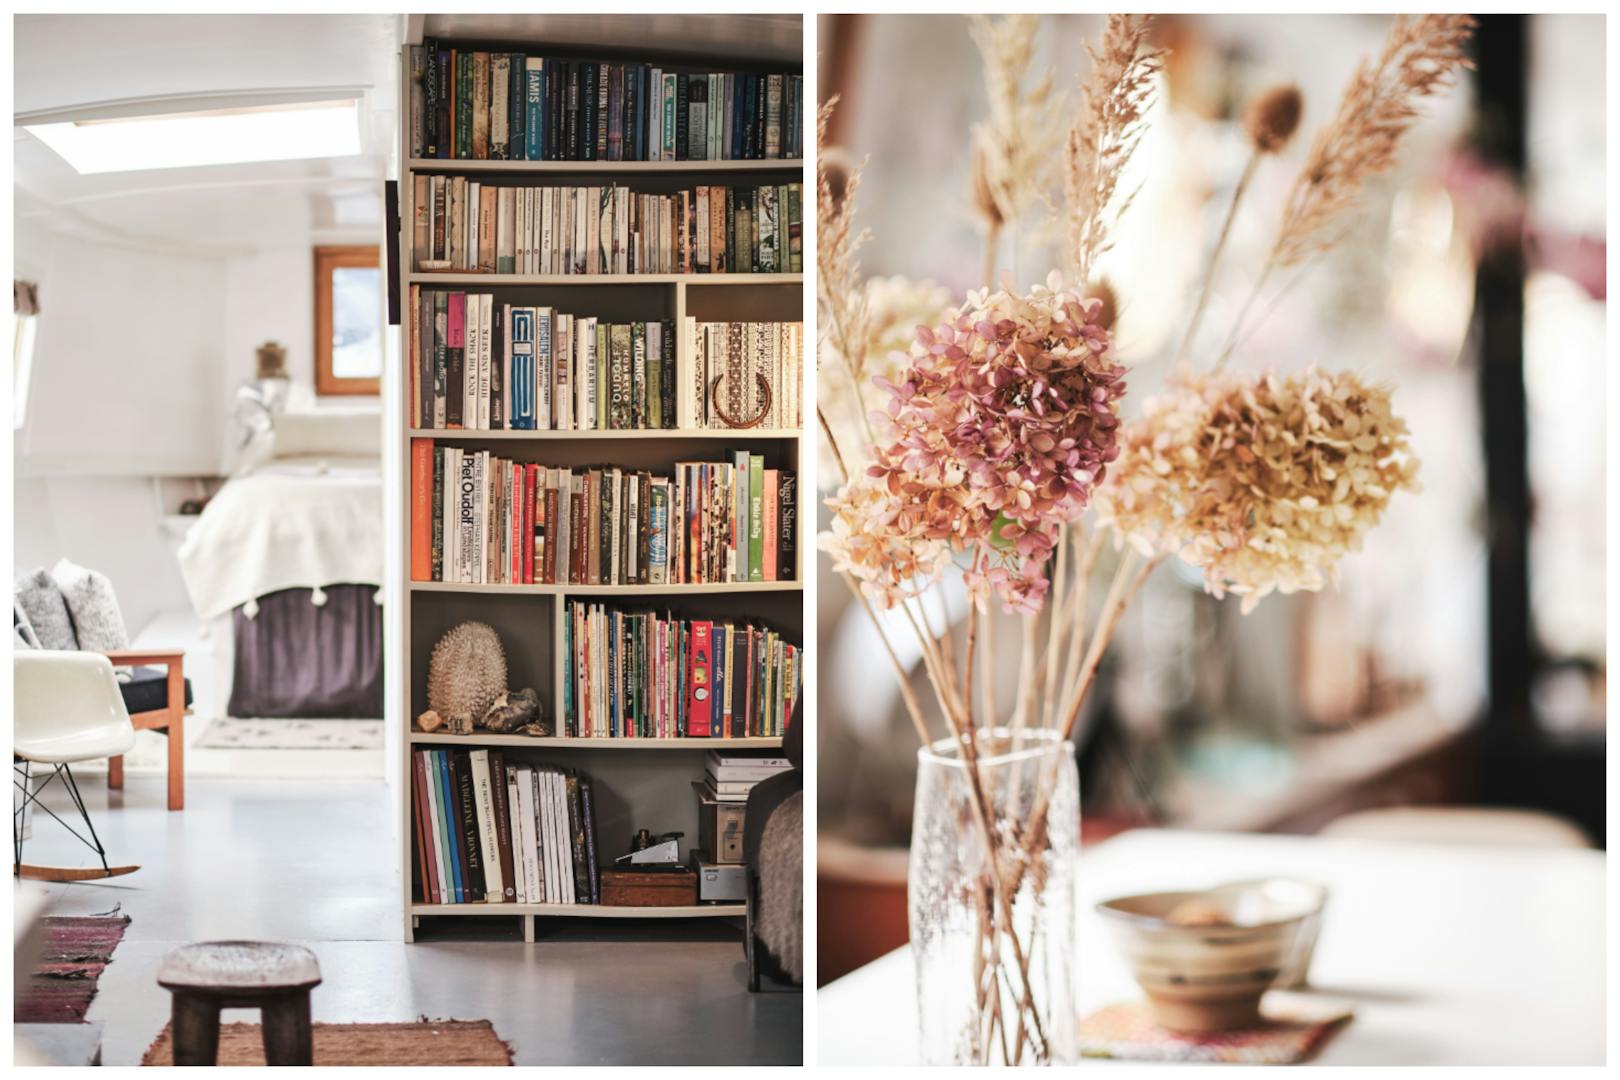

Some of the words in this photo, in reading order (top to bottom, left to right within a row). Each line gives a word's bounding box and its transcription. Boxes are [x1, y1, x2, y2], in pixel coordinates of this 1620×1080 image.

[529, 74, 540, 103] AMIS
[679, 77, 687, 108] BURIAL
[679, 112, 687, 138] RITES
[467, 328, 477, 354] SHACK
[481, 328, 489, 352] SEEK
[539, 315, 550, 355] JERUSALEM
[468, 357, 477, 371] THE
[481, 354, 489, 372] AND
[588, 345, 596, 404] HERBARIUM
[612, 350, 622, 402] OUDOLF
[622, 349, 630, 401] HUMMELO
[468, 376, 477, 396] ROCK
[481, 375, 490, 398] HIDE
[462, 458, 474, 480] Piet
[462, 481, 474, 525] Oudolf
[779, 475, 796, 505] Nigel
[474, 512, 482, 543] STEPHAN
[782, 507, 796, 540] Slater
[460, 773, 473, 824] MADELEINE
[466, 830, 478, 869] VIONNET
